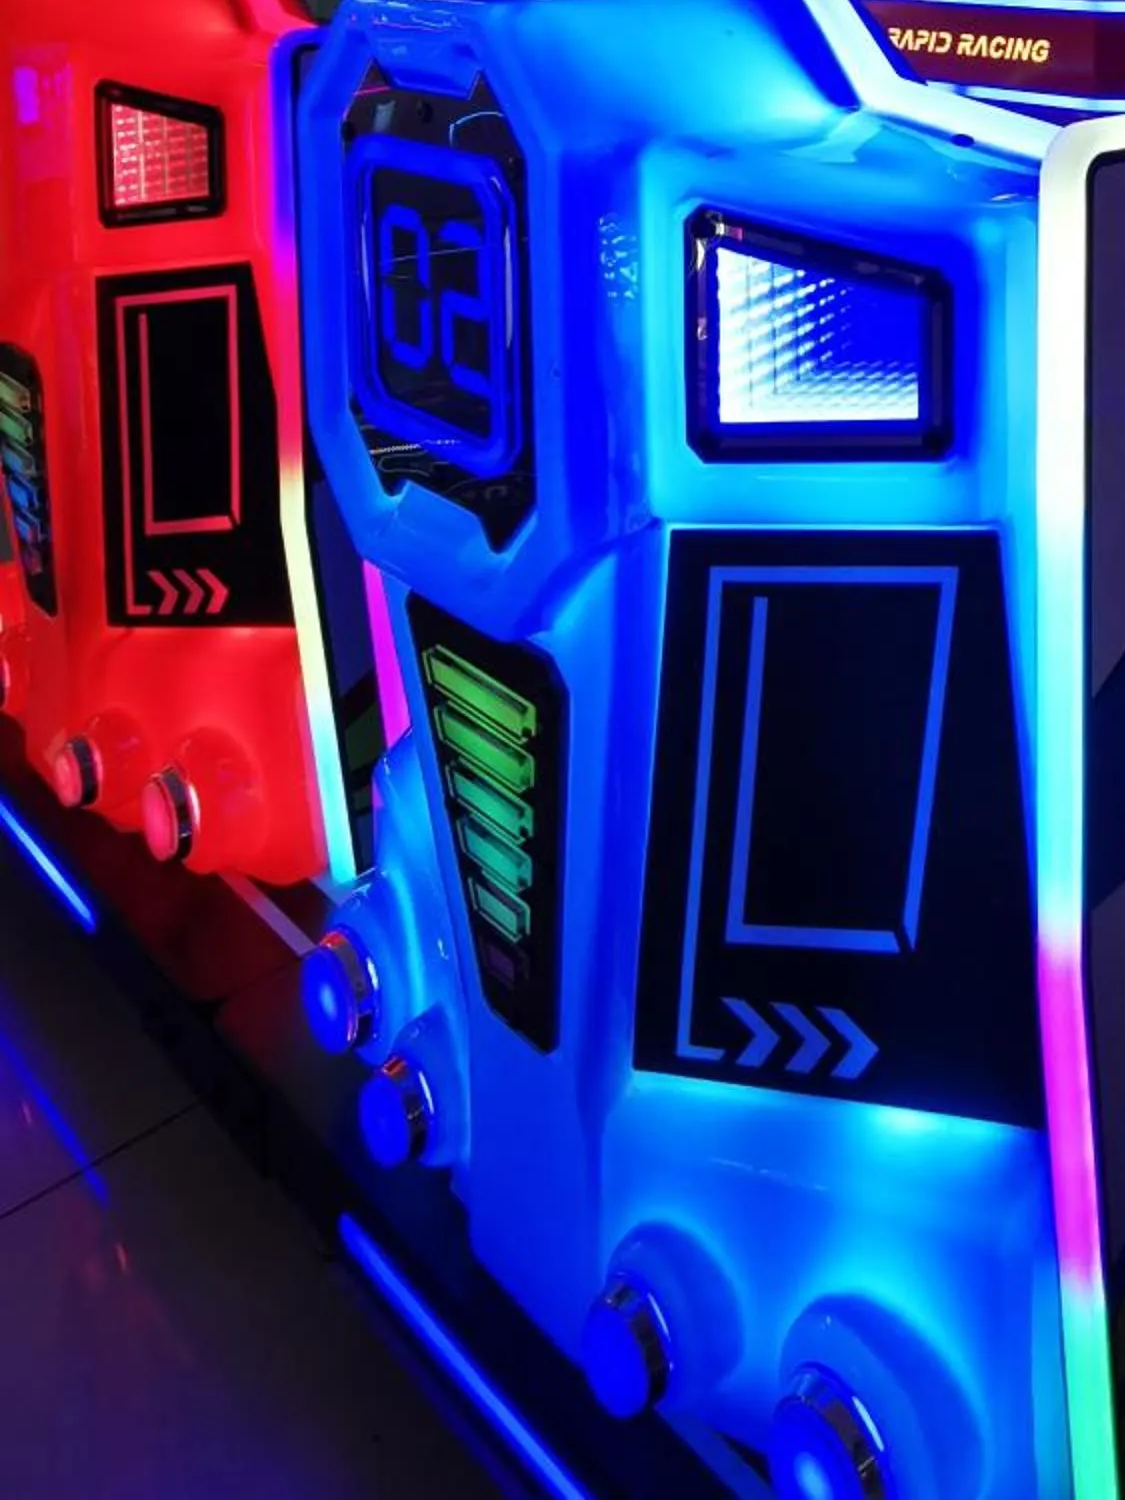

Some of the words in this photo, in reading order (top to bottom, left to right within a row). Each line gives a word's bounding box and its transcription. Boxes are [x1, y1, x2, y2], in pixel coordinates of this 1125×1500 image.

[888, 27, 953, 54] RAPID
[956, 33, 1051, 63] RACING
[380, 204, 492, 400] 02
